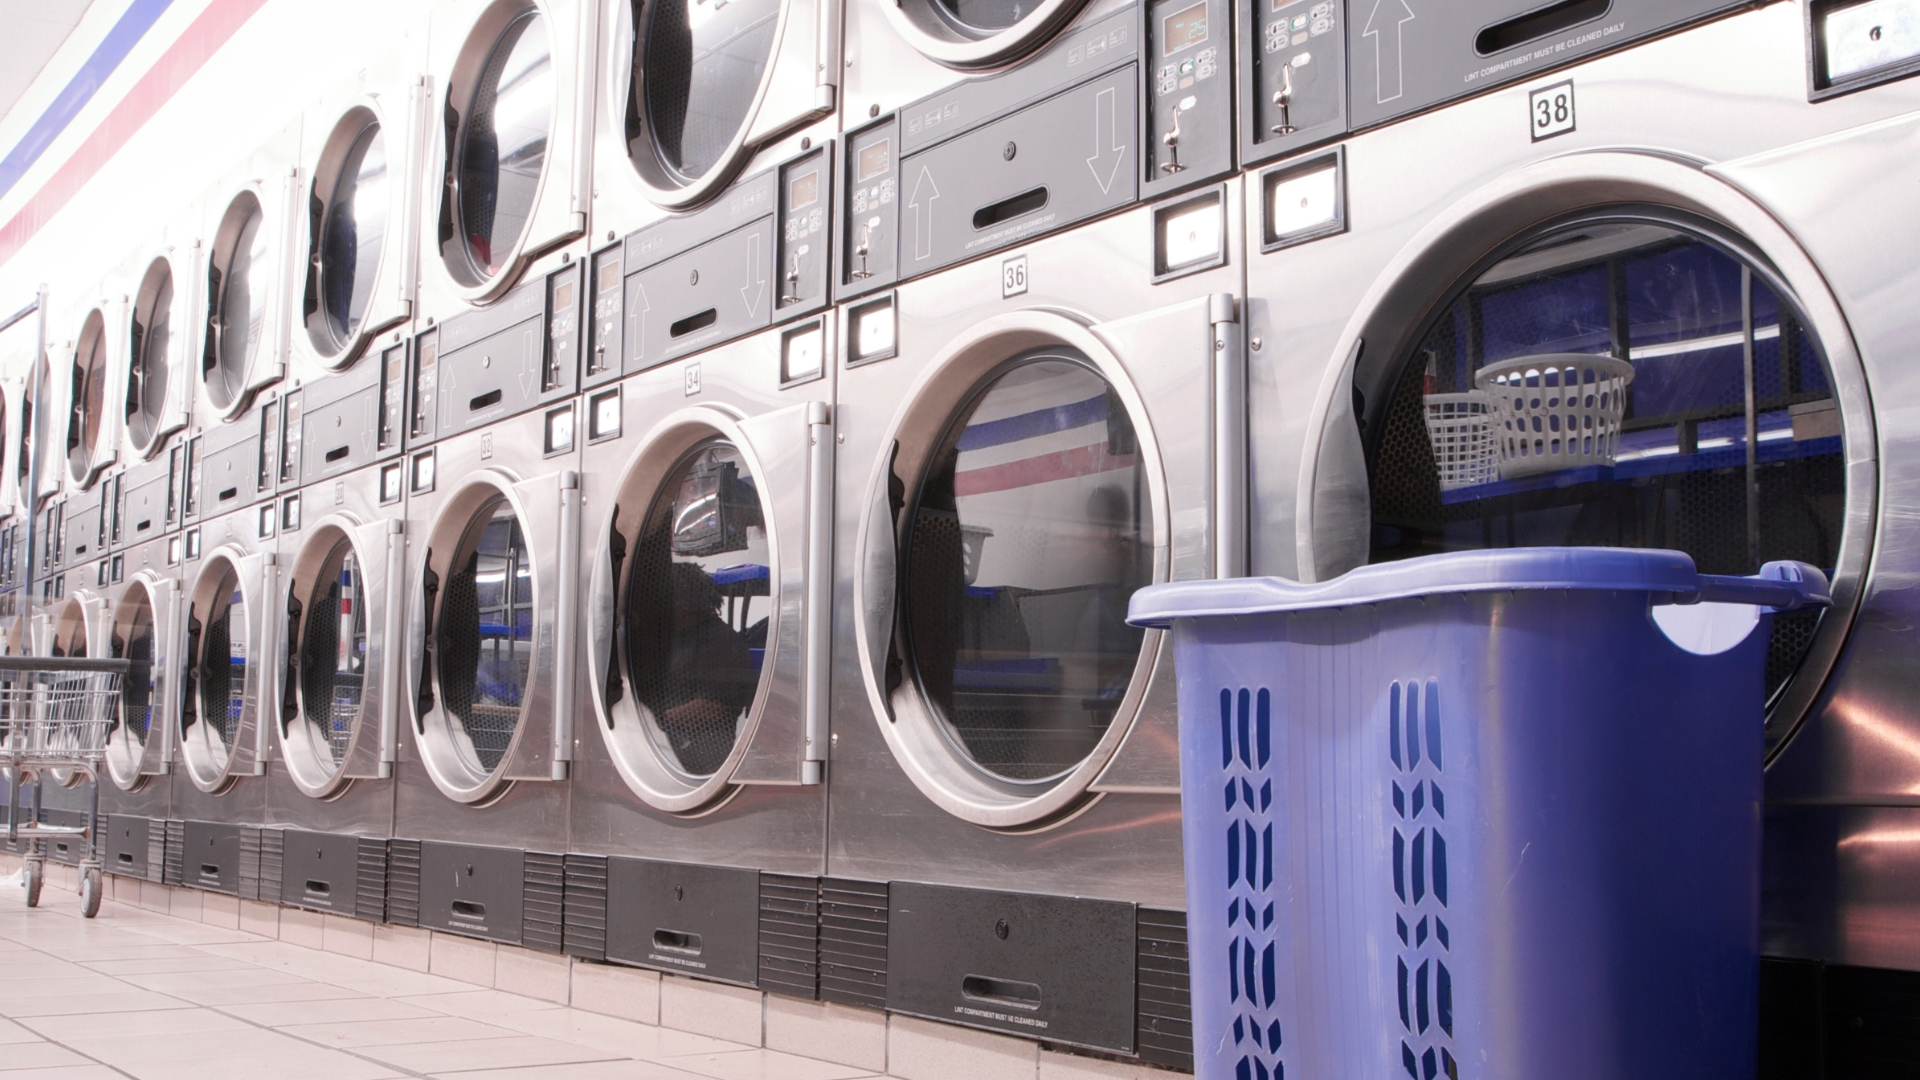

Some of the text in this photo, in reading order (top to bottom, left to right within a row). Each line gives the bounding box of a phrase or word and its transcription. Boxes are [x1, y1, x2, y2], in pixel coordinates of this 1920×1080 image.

[1464, 22, 1625, 83] LINT COMPARTMENT MUST BE CLEANED DAILY
[1537, 93, 1568, 128] 38
[1006, 264, 1024, 289] 36
[687, 370, 699, 389] 34
[482, 438, 491, 454] 32
[954, 1005, 964, 1014] LINT
[963, 1007, 995, 1019] COMPARTMENT
[994, 1012, 1008, 1021] MUST
[1014, 1016, 1035, 1026] CLEANED
[1034, 1019, 1049, 1029] DAILY
